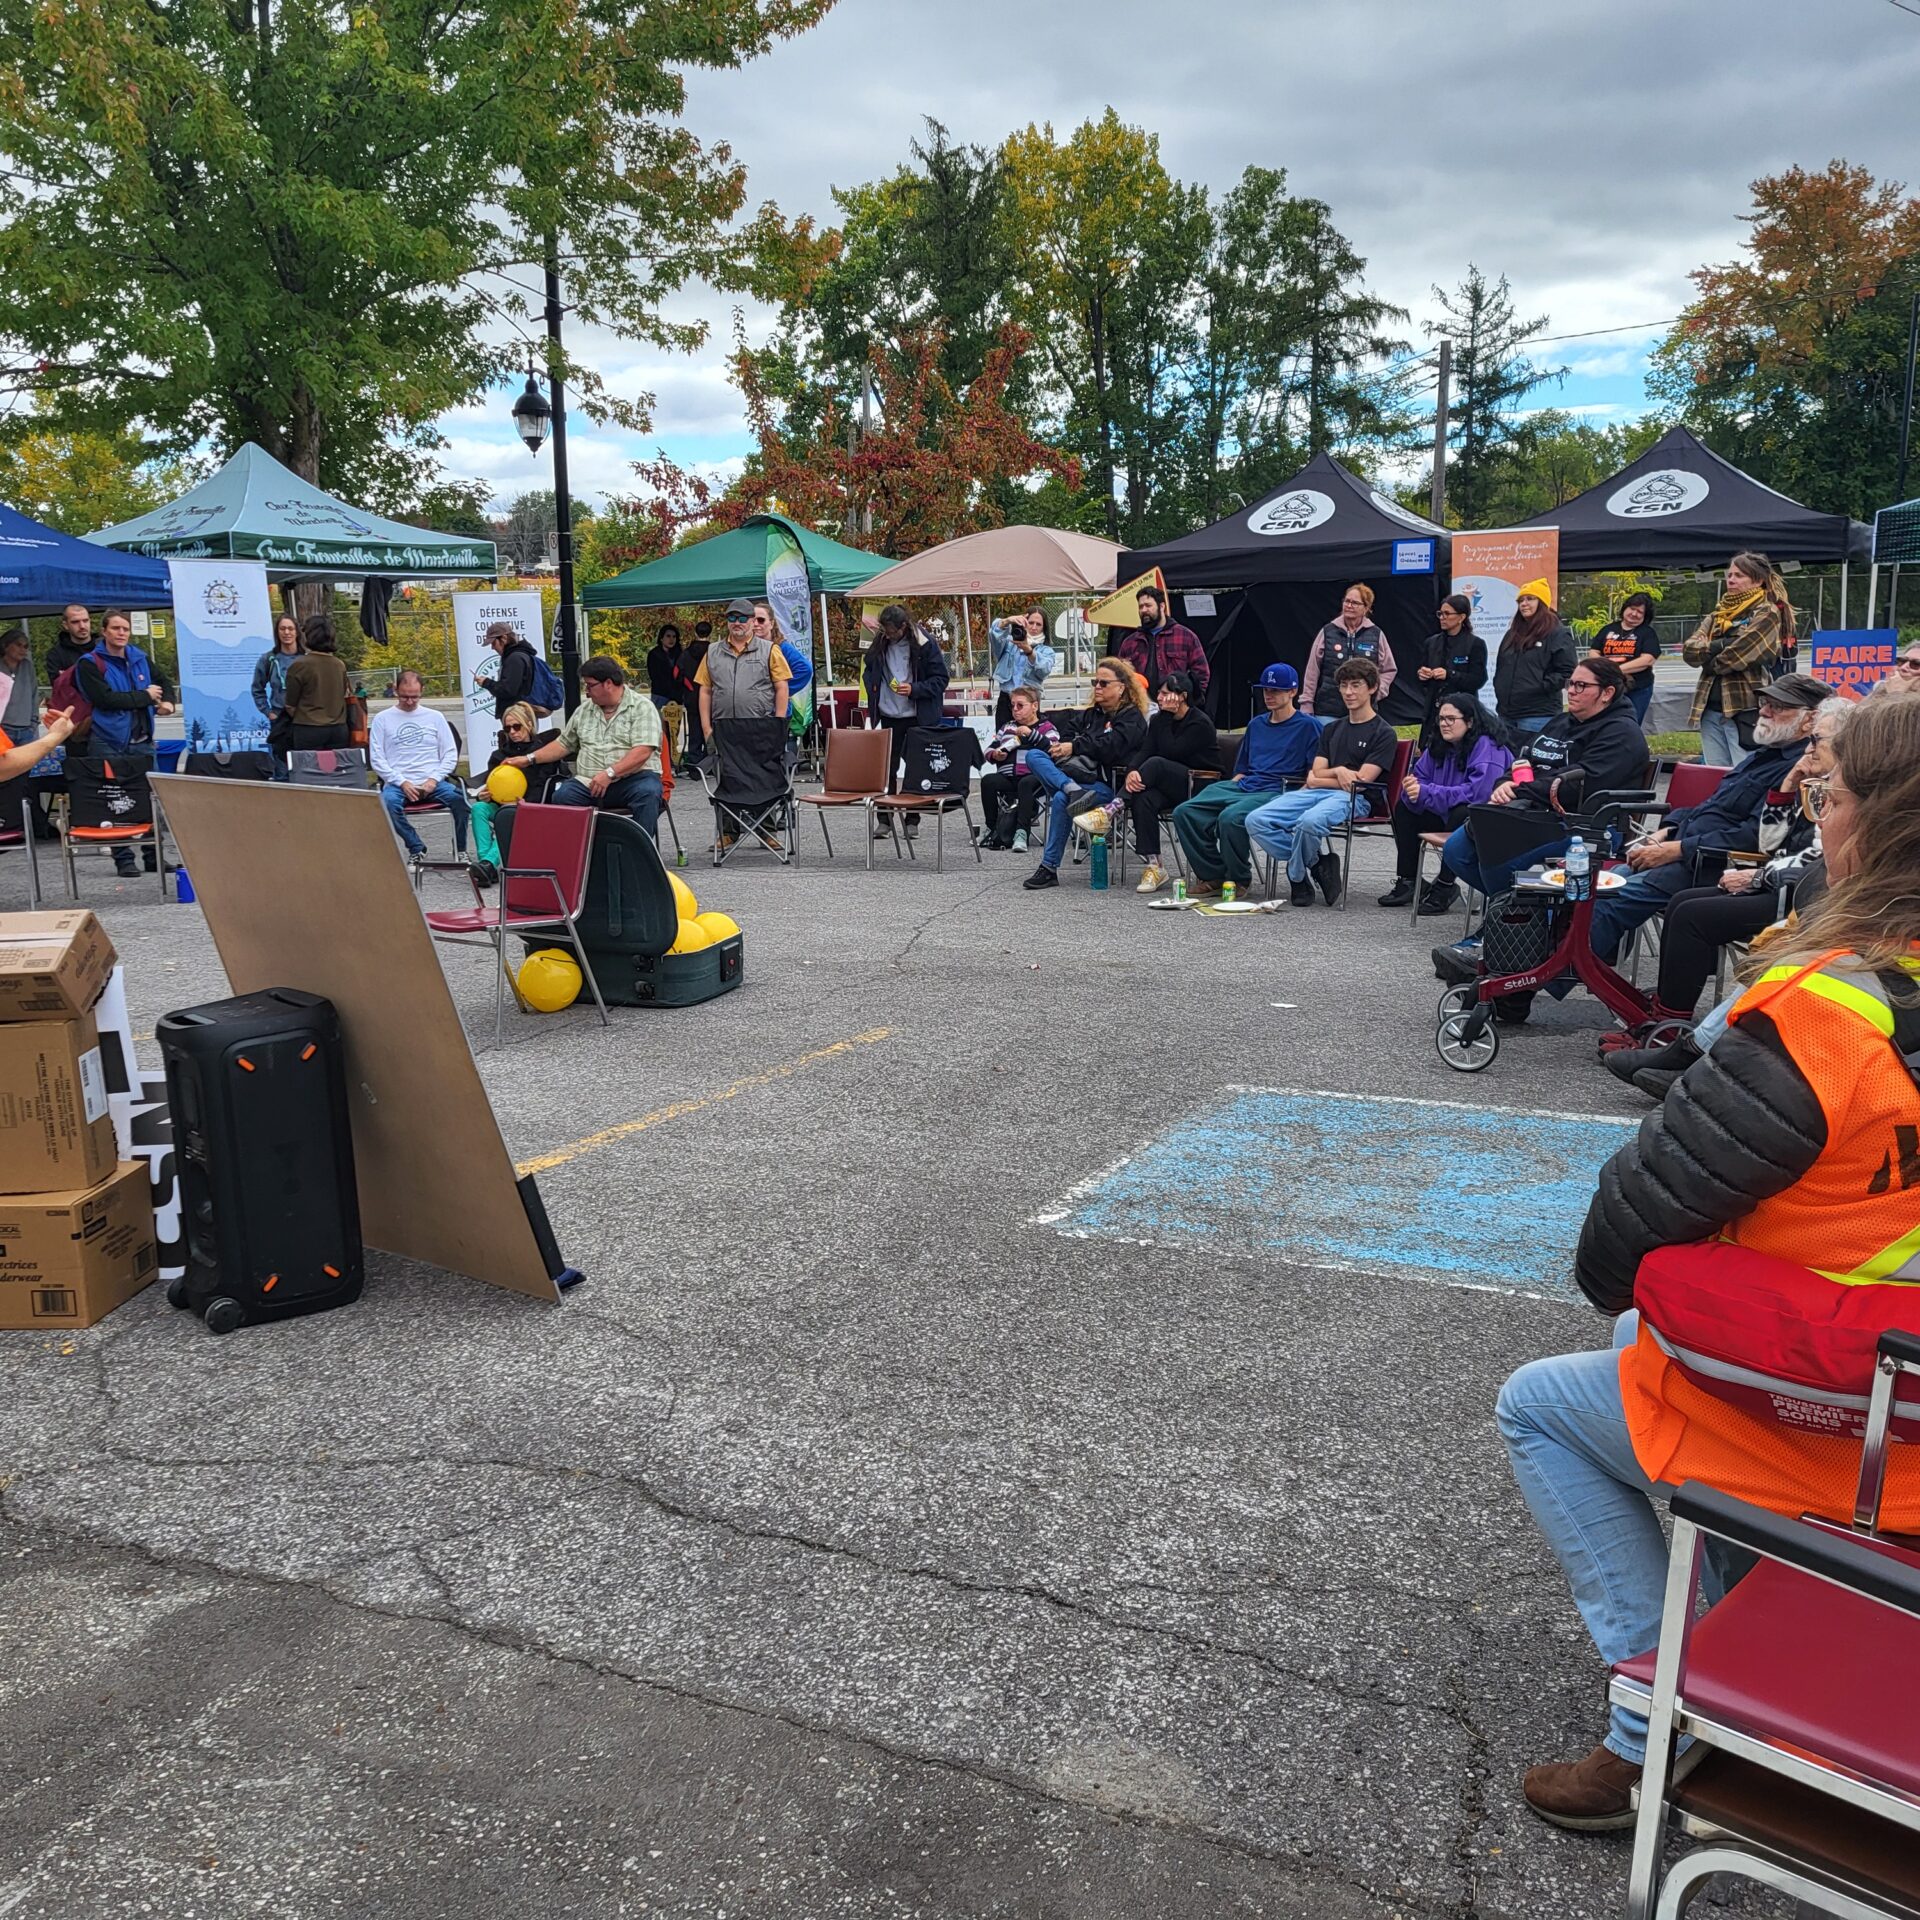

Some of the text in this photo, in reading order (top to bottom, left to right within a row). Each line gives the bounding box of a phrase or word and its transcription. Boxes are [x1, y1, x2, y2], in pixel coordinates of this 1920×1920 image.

[1624, 502, 1682, 514] CSN
[1260, 520, 1310, 531] CSN
[256, 539, 481, 569] Aux Trouvailles de Mandeville
[480, 606, 518, 618] DÉFENSE
[1815, 646, 1893, 664] FAIRE
[1812, 666, 1897, 684] FRONT
[230, 731, 270, 739] BONJOU
[1504, 976, 1536, 990] Stella
[0, 1260, 38, 1270] ectrices
[0, 1272, 43, 1282] derwear
[1768, 1393, 1825, 1411] TROUSSE
[1773, 1399, 1868, 1424] PREMIER
[1777, 1408, 1842, 1427] SOINS
[1779, 1417, 1804, 1426] FIRST
